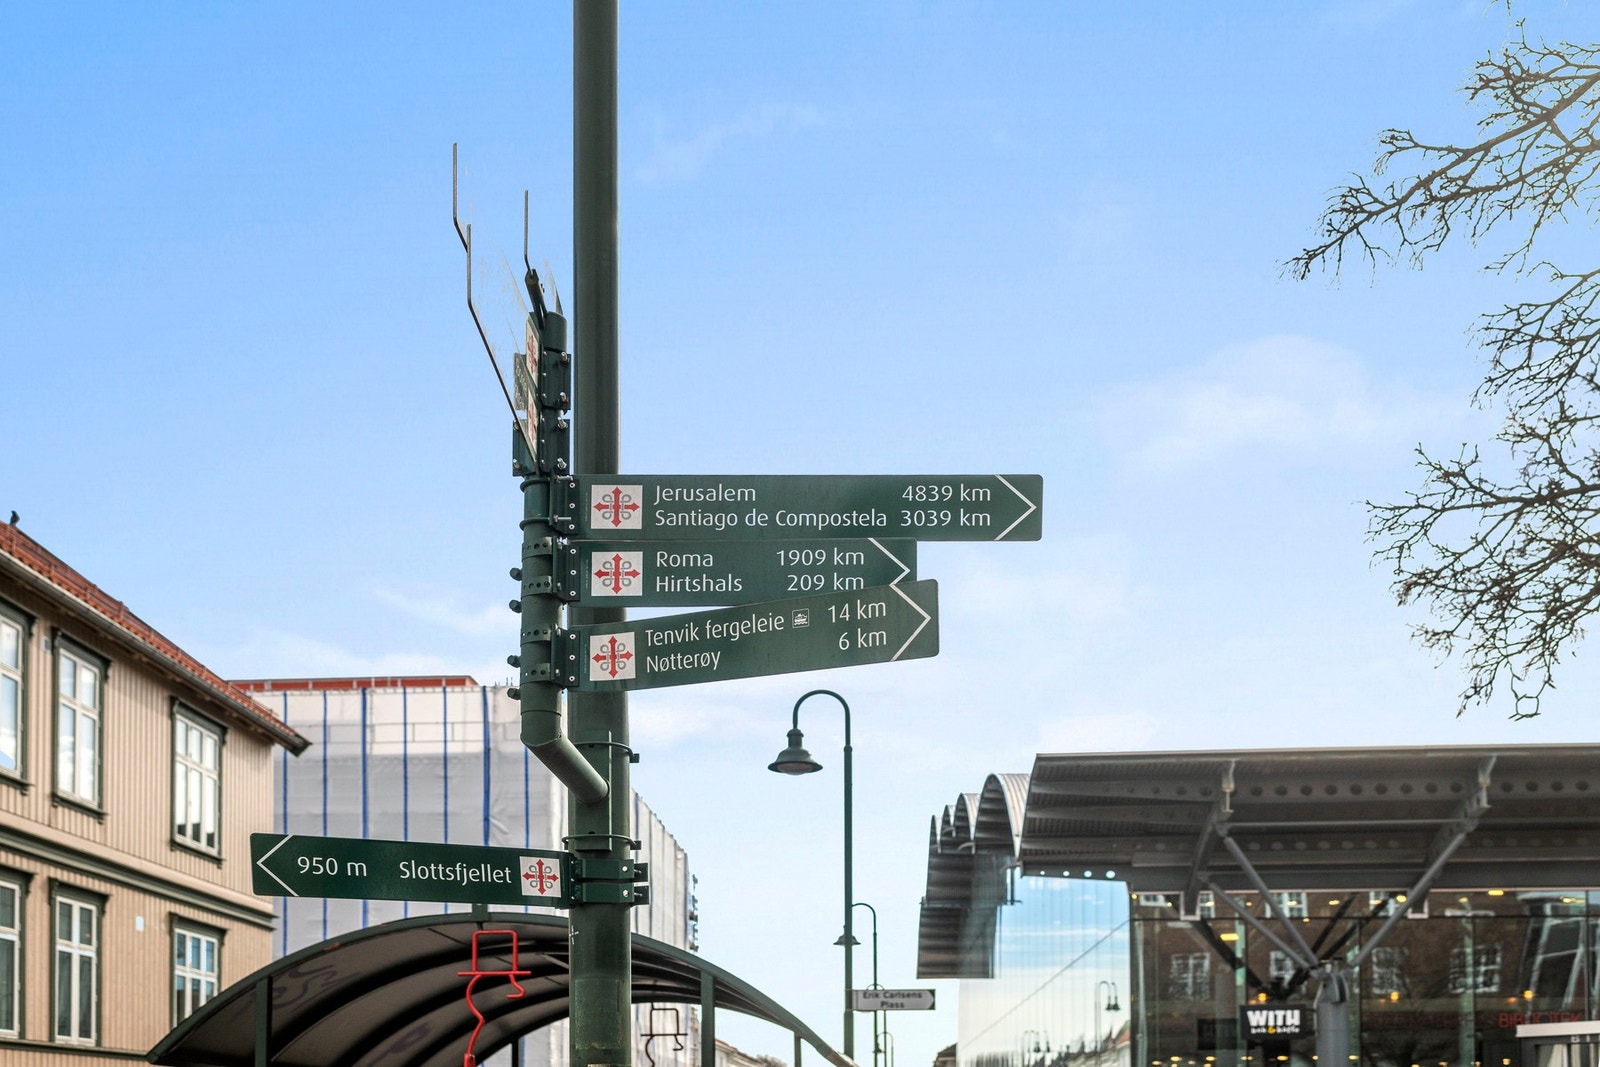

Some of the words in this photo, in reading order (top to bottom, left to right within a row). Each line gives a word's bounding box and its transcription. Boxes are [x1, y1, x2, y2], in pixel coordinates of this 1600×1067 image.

[653, 483, 756, 505] Jerusalem
[902, 485, 953, 502] 4839
[960, 483, 991, 501] km
[655, 509, 738, 530] Santiago
[745, 509, 769, 526] de
[775, 508, 887, 530] Compostela
[900, 509, 952, 527] 3039
[960, 508, 991, 526] km
[656, 551, 714, 568] Roma
[776, 549, 826, 566] 1909
[833, 548, 865, 565] km
[656, 574, 743, 592] Hirtshals
[787, 574, 825, 591] 209
[833, 572, 864, 590] km
[645, 622, 700, 647] Tenvik
[706, 612, 785, 641] fergeleie
[828, 602, 851, 623] 14
[857, 599, 887, 620] km
[646, 650, 721, 673] Nøtterøy
[838, 634, 850, 650] 6
[857, 628, 887, 648] km
[297, 856, 338, 875] 950
[347, 861, 367, 877] m
[399, 859, 512, 886] Slottsfjellet
[863, 991, 880, 999] Erik
[880, 1001, 904, 1009] Plass
[1246, 1009, 1300, 1026] WITH
